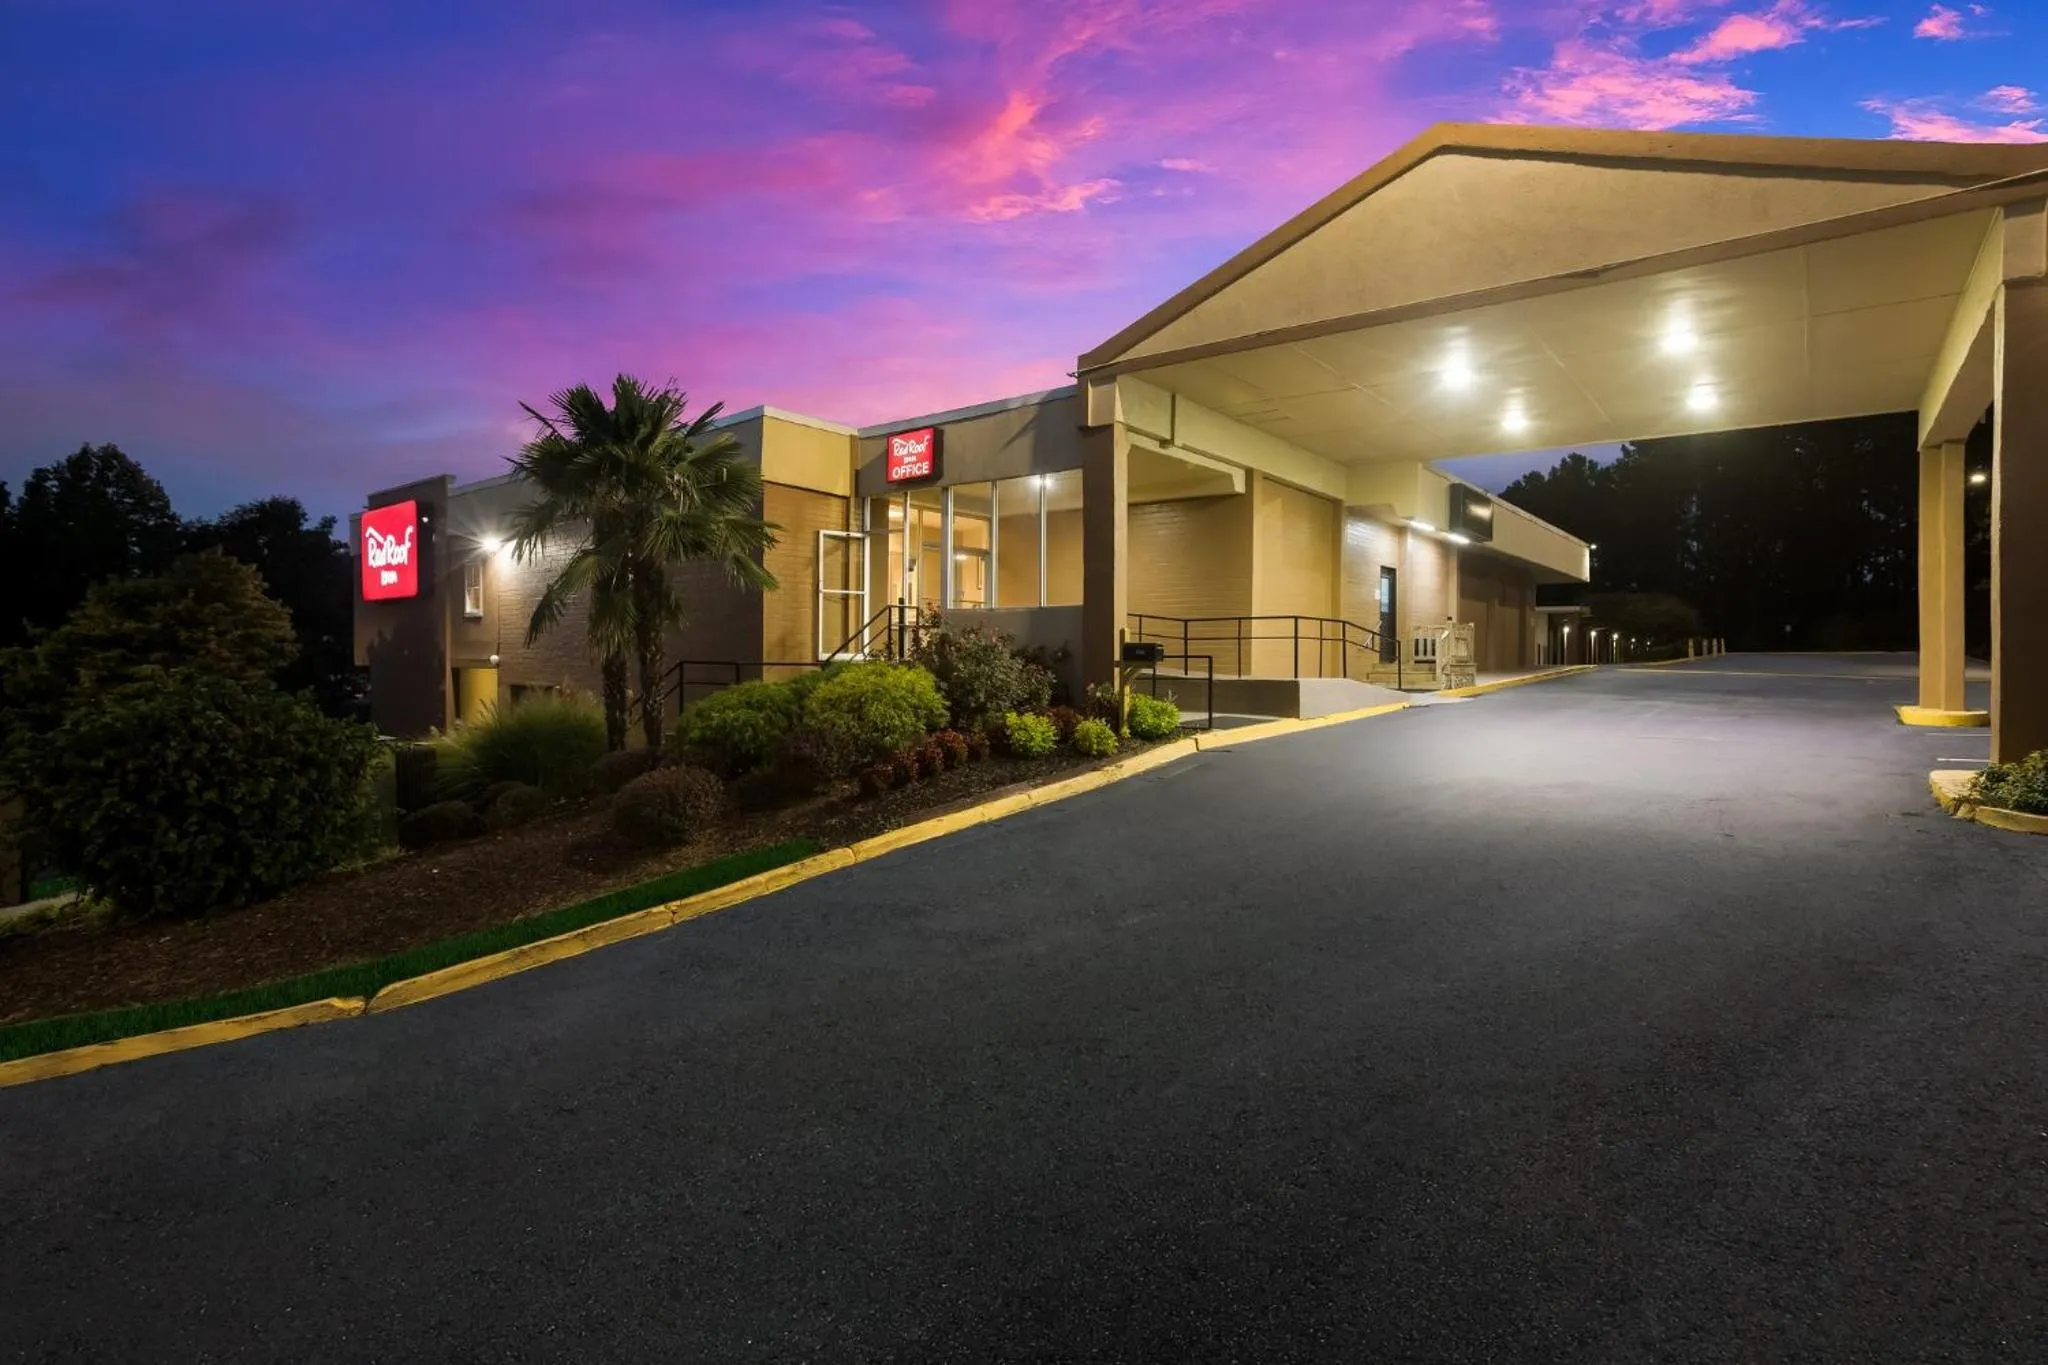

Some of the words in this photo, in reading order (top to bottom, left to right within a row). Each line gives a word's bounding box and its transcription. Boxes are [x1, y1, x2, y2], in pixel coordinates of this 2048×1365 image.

[892, 438, 909, 457] Red
[909, 435, 931, 454] Roof
[892, 461, 929, 480] OFFICE
[365, 525, 387, 568] Red
[386, 524, 414, 566] Roof
